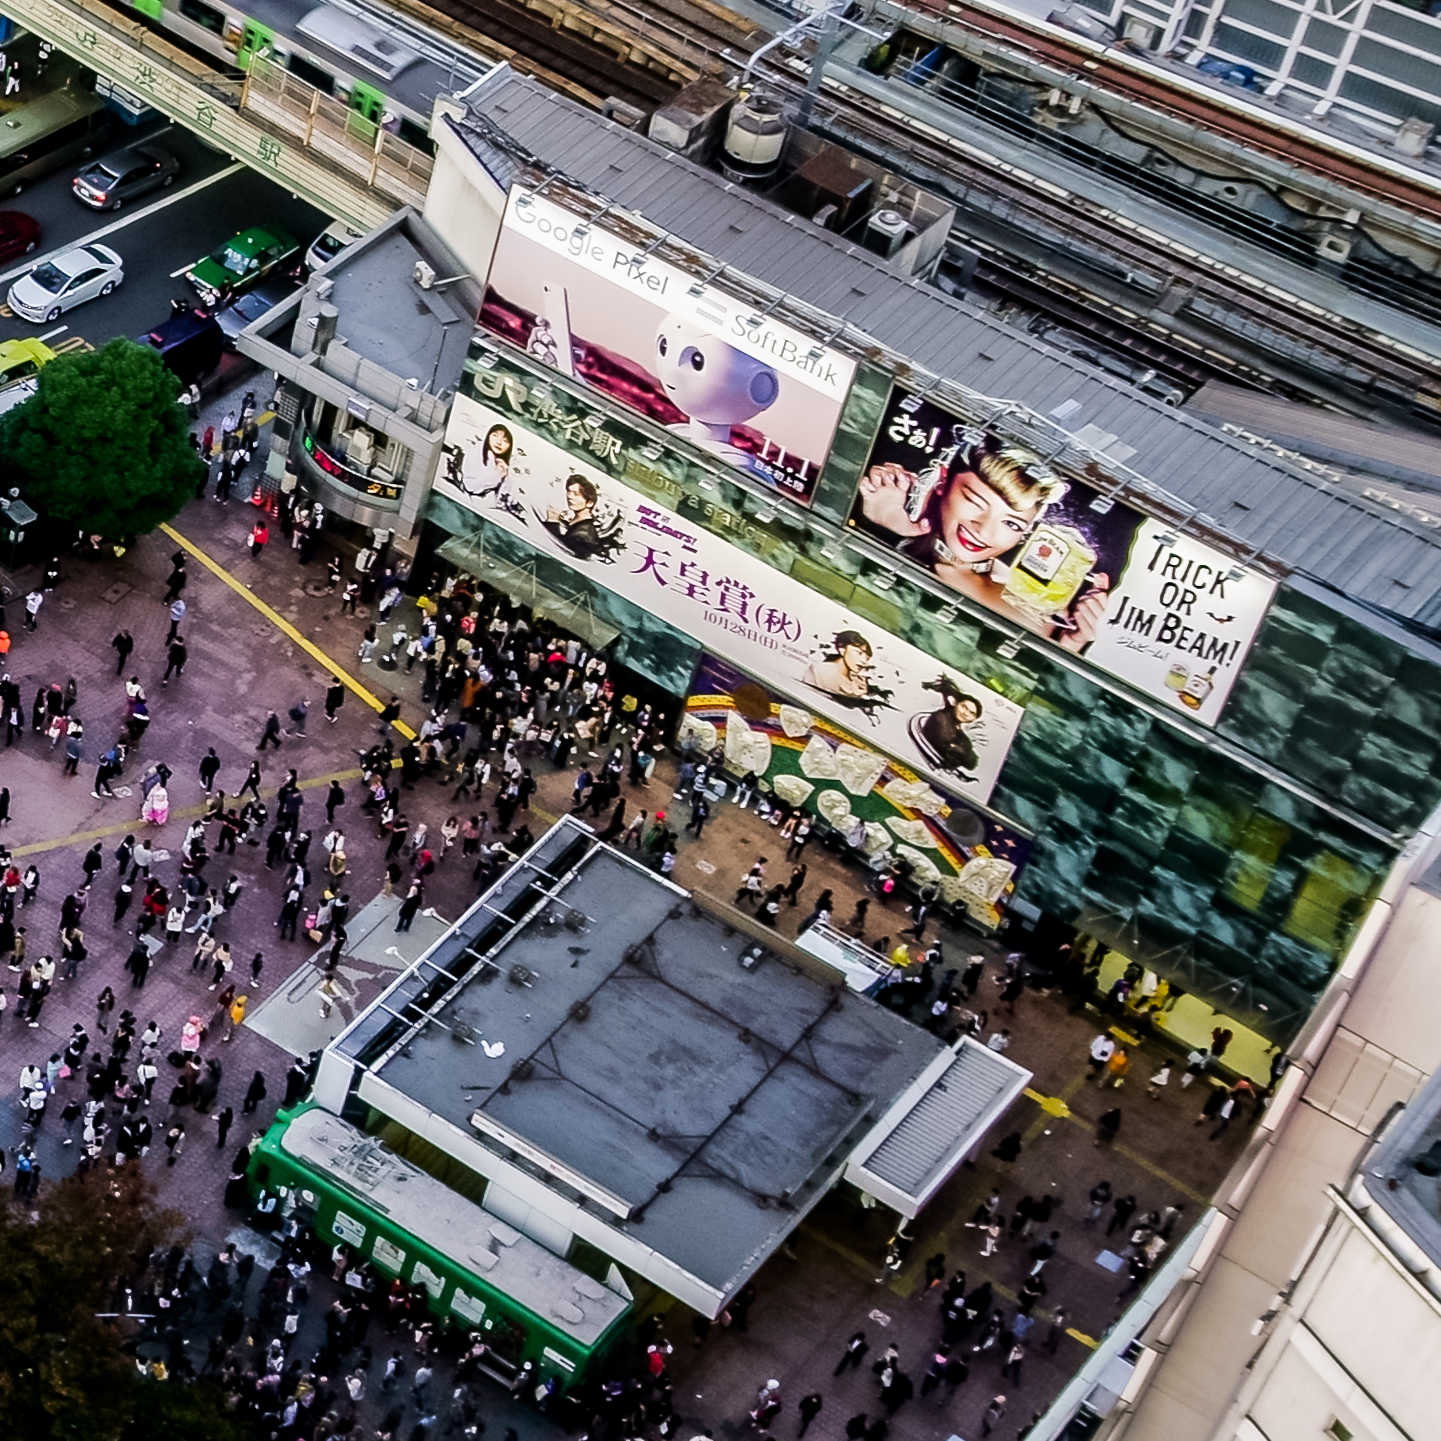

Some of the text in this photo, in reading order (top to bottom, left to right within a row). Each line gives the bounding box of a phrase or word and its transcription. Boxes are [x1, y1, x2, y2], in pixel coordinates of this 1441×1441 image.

[515, 196, 671, 297] Google Pixel
[731, 313, 839, 388] SoftBank
[529, 400, 623, 466] 渋谷駅
[757, 437, 811, 483] 11.1
[630, 540, 803, 643] 天皇賞(秋)
[1147, 534, 1227, 599] TRICK
[702, 610, 779, 651] 10月28日(日)
[1107, 596, 1157, 639] JIM
[1159, 582, 1198, 617] OR
